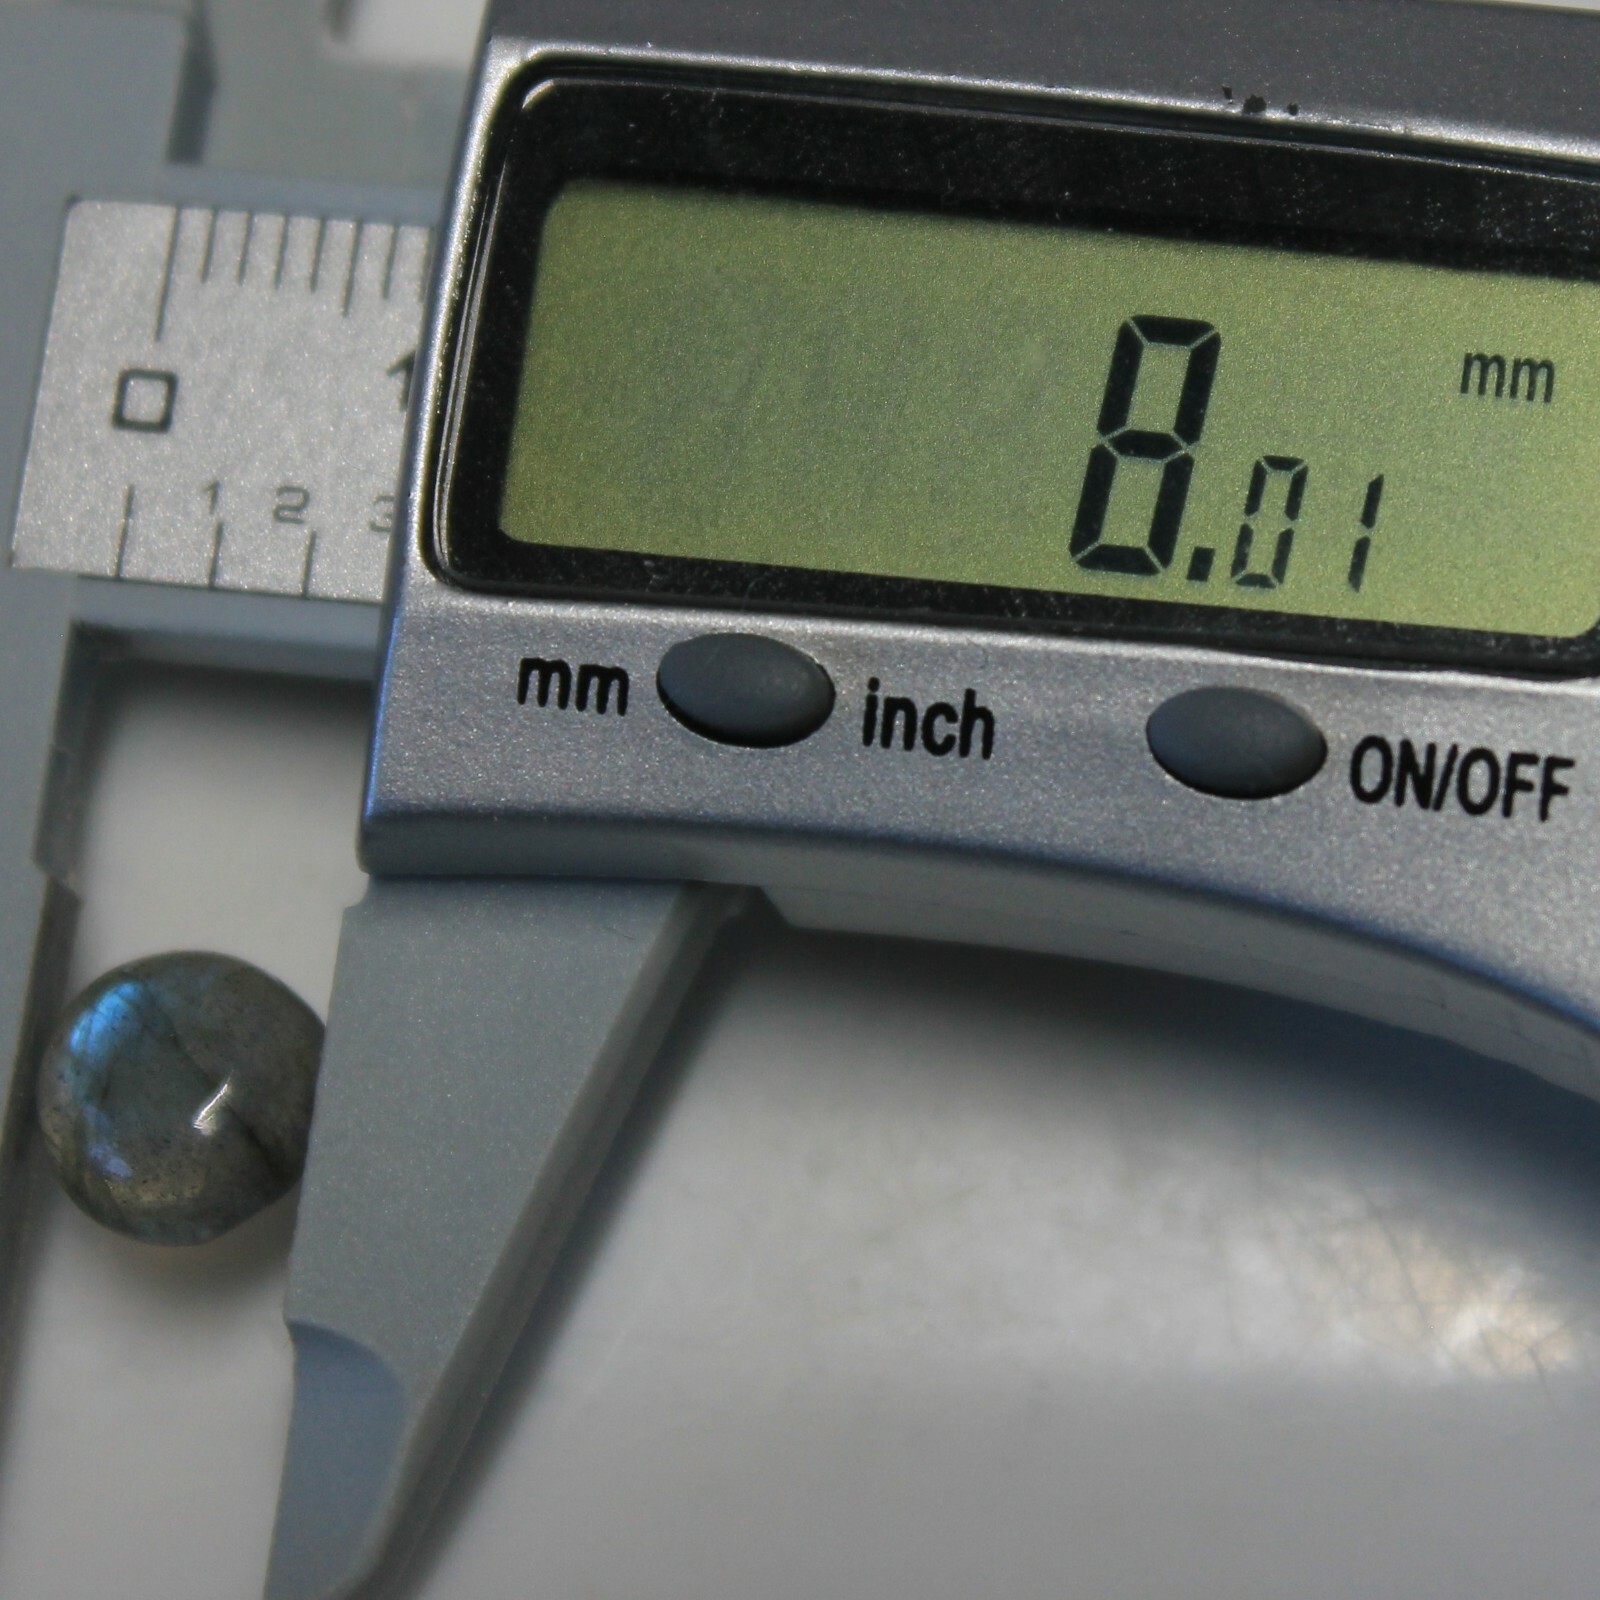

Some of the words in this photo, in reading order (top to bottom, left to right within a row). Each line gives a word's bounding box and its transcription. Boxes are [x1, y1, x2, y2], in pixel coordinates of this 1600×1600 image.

[111, 367, 179, 434] 0
[1460, 351, 1556, 404] mm
[1069, 314, 1385, 593] 8.01
[203, 479, 221, 515] 1
[273, 485, 311, 525] 2
[516, 656, 630, 717] mm
[861, 676, 997, 761] inch
[1350, 734, 1576, 823] ON/OFF
